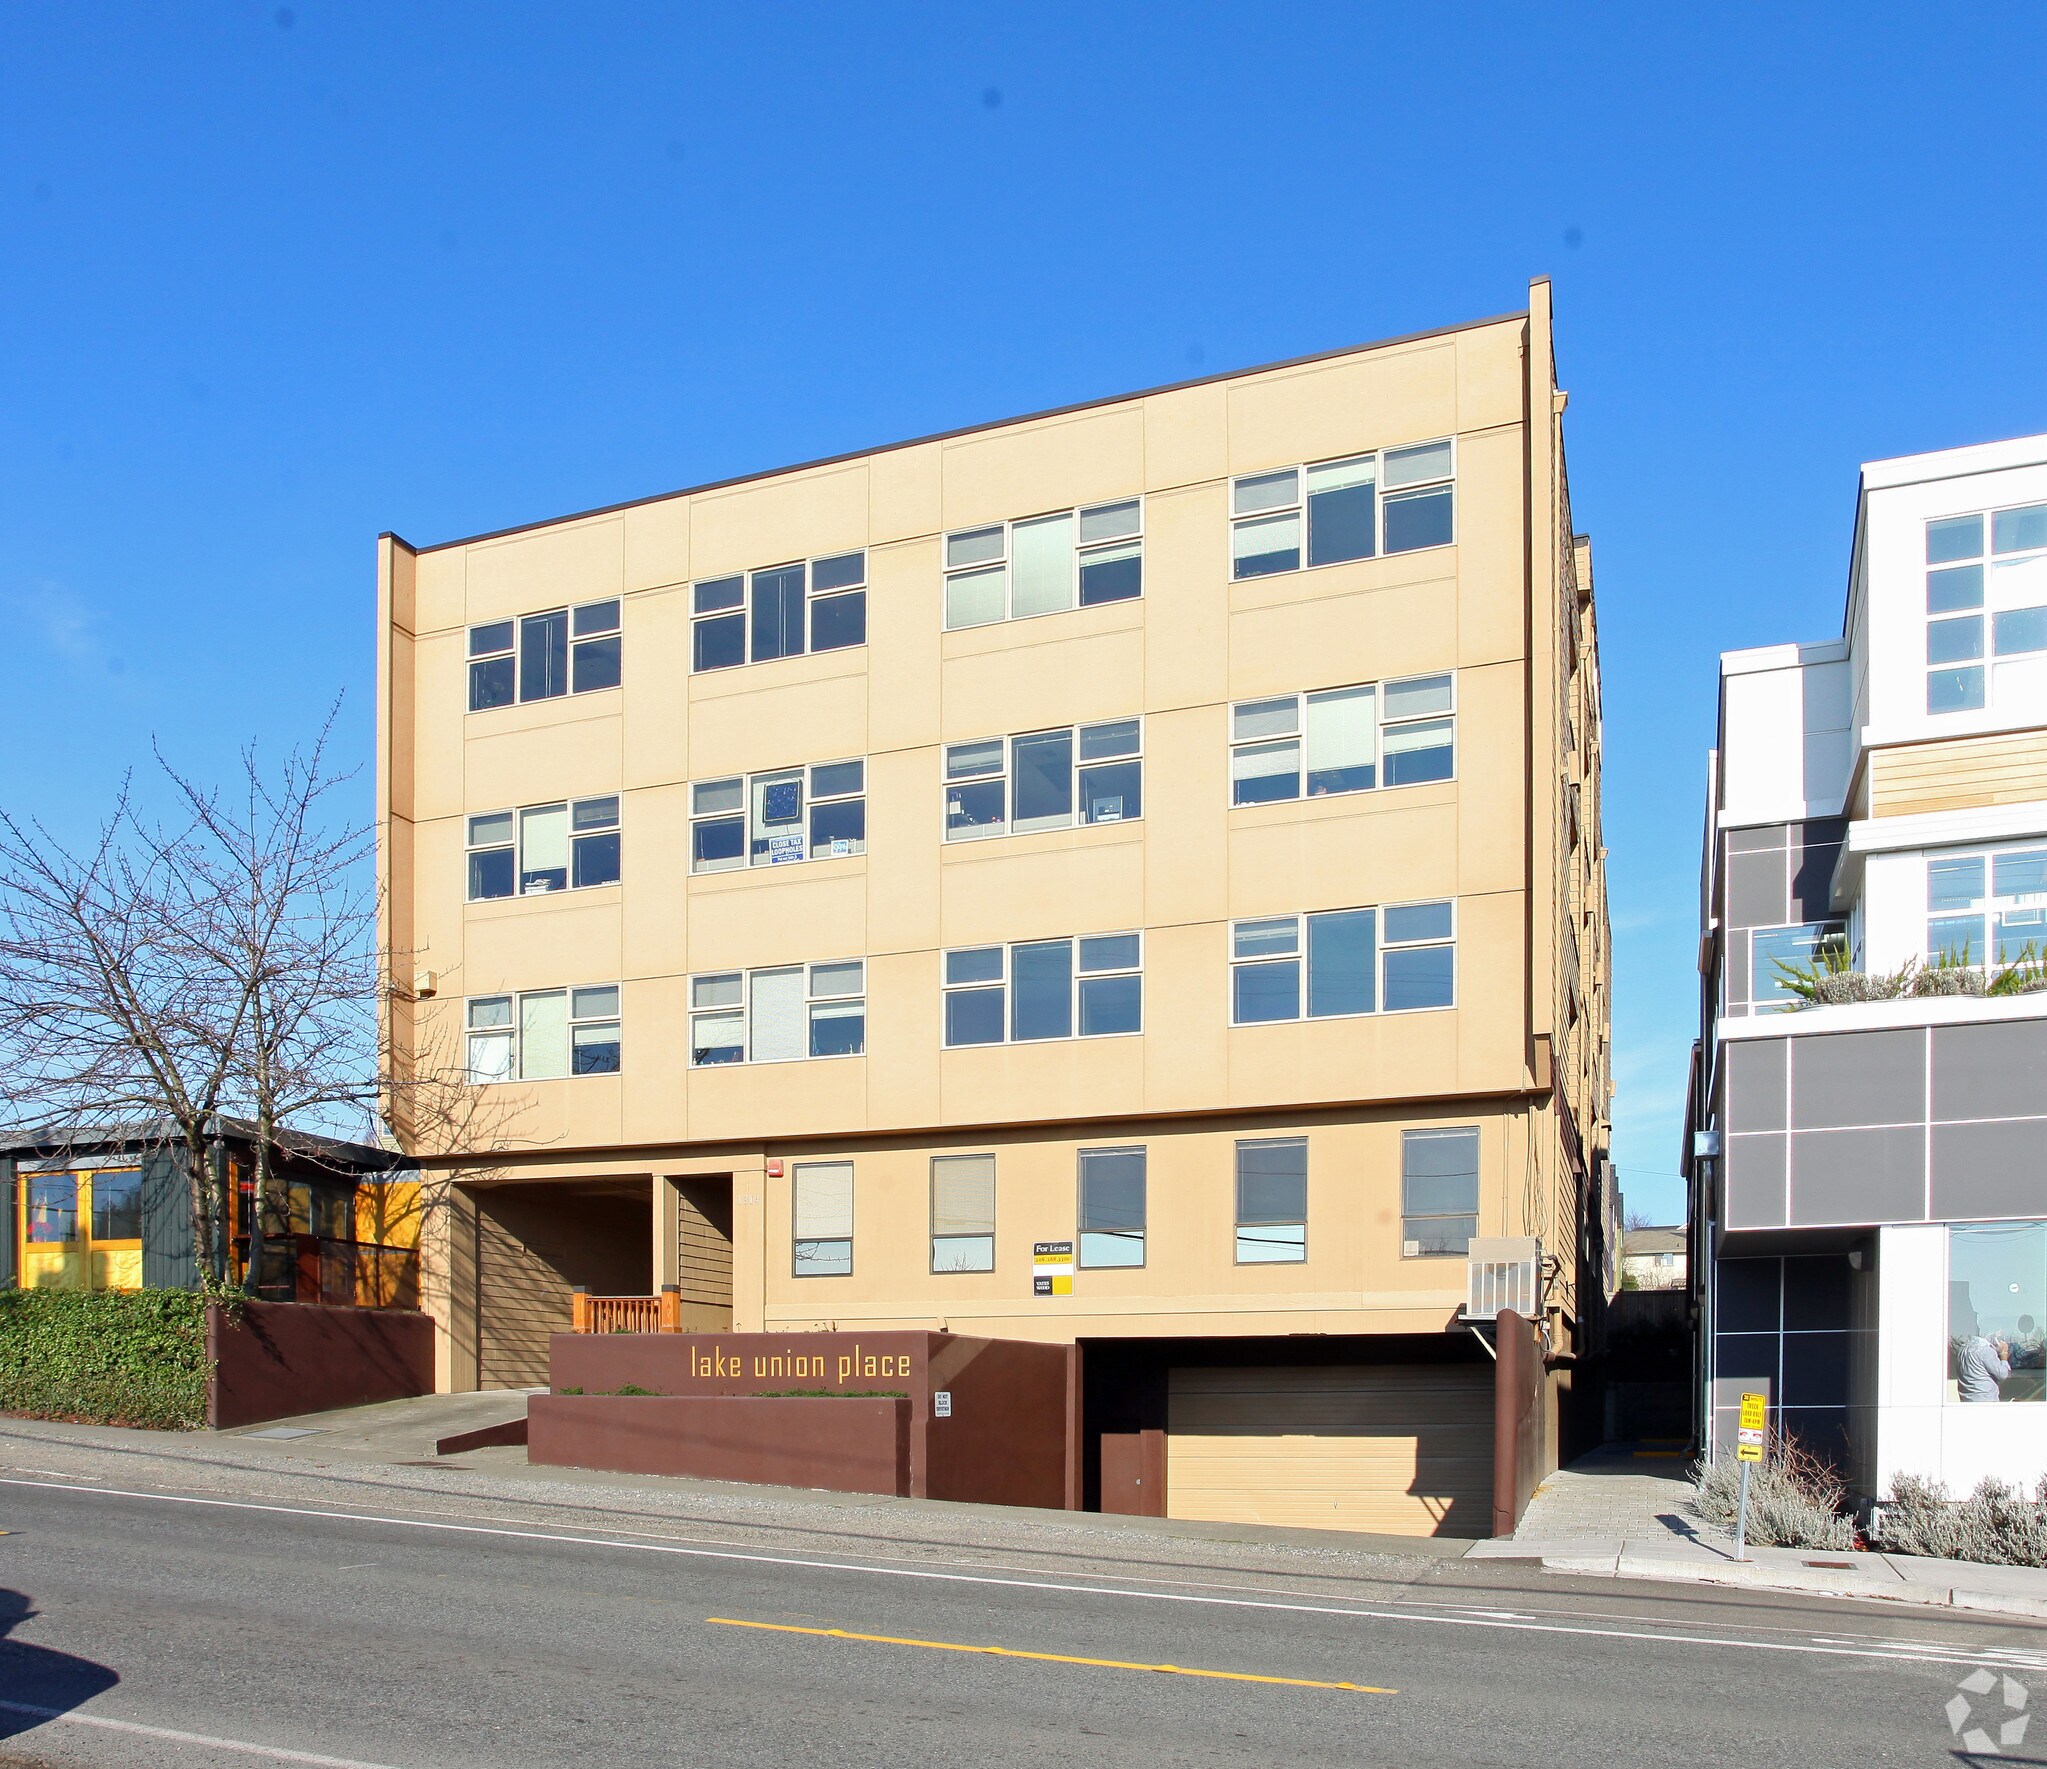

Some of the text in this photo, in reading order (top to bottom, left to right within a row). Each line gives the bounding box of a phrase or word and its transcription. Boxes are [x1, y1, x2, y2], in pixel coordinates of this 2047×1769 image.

[772, 838, 802, 849] CLOSE TAX
[771, 845, 803, 855] LOOPHOLES
[1036, 1245, 1049, 1253] For
[691, 1344, 911, 1384] lake union place
